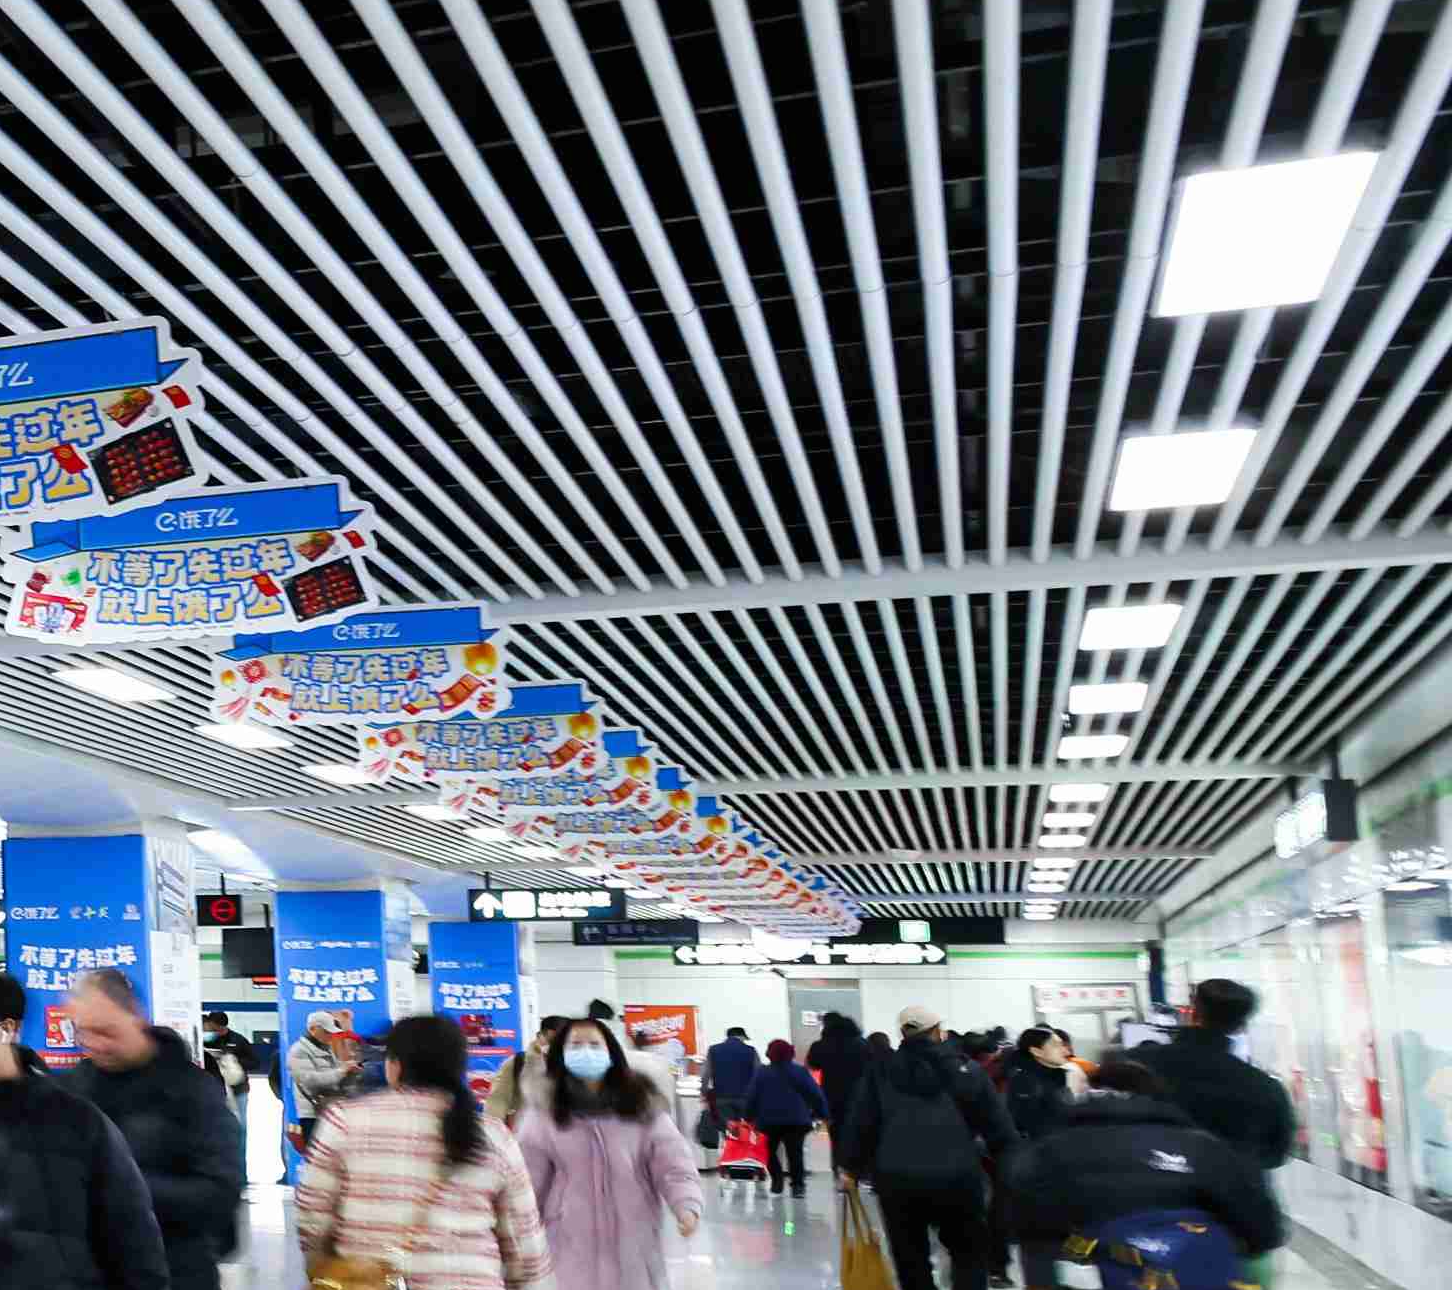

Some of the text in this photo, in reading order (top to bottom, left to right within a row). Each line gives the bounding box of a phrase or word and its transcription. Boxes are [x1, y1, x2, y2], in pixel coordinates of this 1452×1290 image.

[87, 538, 295, 586] 不等了先过年
[97, 585, 284, 625] 就上饿了么
